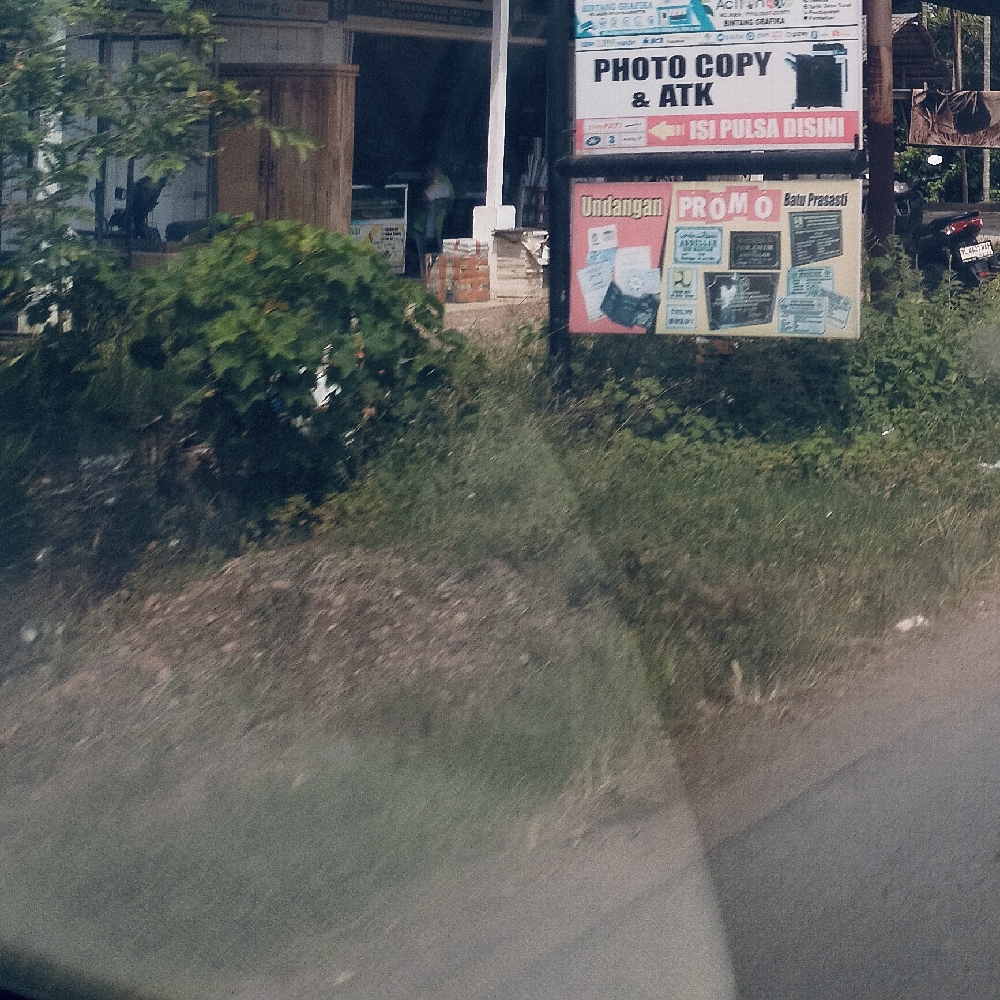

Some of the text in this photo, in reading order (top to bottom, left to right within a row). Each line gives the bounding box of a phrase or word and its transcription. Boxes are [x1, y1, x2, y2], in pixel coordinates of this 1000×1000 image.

[723, 17, 785, 27] BINTANG GRAFIKA
[594, 51, 773, 84] PHOTO COPY
[631, 82, 715, 108] & ATK
[689, 116, 846, 141] ISI PULSA DISINI
[580, 194, 664, 219] Undangan
[783, 191, 849, 208] Batu Prasasti
